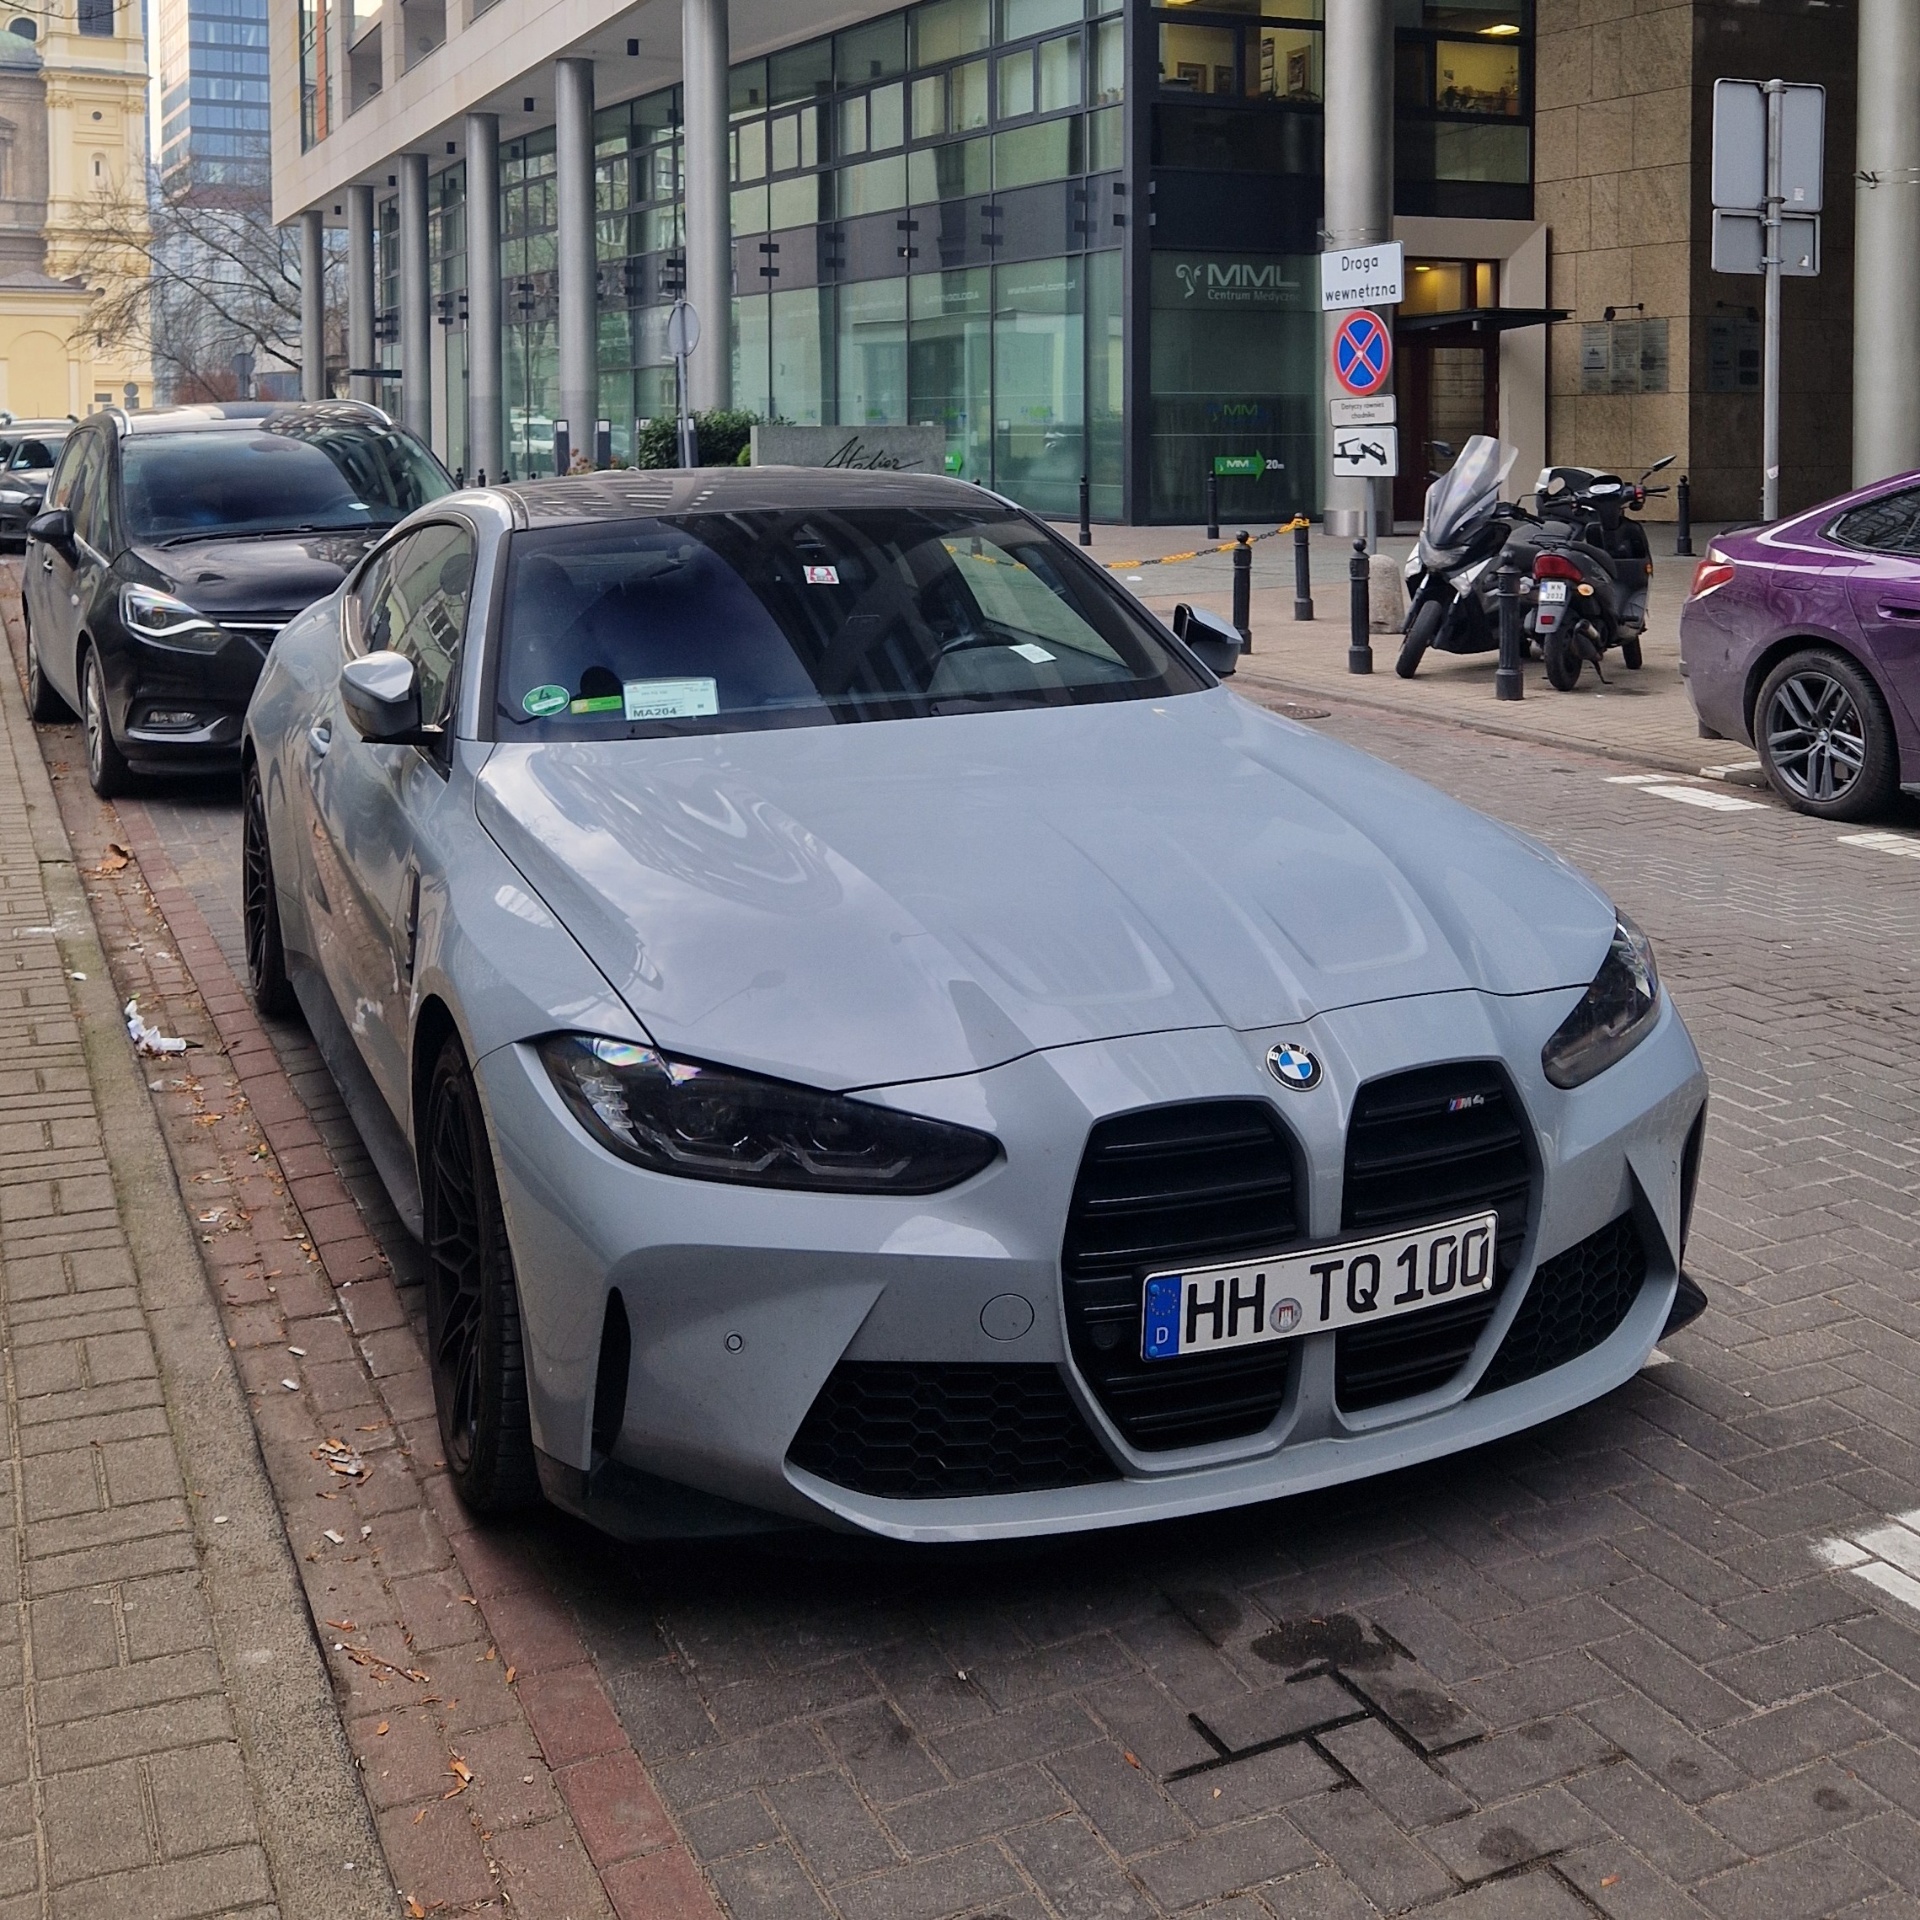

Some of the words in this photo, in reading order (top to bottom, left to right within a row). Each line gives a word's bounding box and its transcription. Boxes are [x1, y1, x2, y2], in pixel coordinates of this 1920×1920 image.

[1341, 256, 1379, 273] Droga
[1207, 263, 1300, 287] MML
[1207, 288, 1251, 300] Centrum
[1325, 283, 1397, 301] wewnętrzna
[823, 435, 924, 470] Atelier
[1265, 459, 1285, 470] 20m
[538, 688, 552, 700] 4
[632, 706, 678, 718] MA204
[1268, 1043, 1311, 1061] BMW
[1459, 1094, 1485, 1110] M4
[1155, 1326, 1170, 1345] D
[1185, 1273, 1266, 1343] HH
[1309, 1254, 1381, 1322] TQ
[1393, 1227, 1489, 1306] 100
